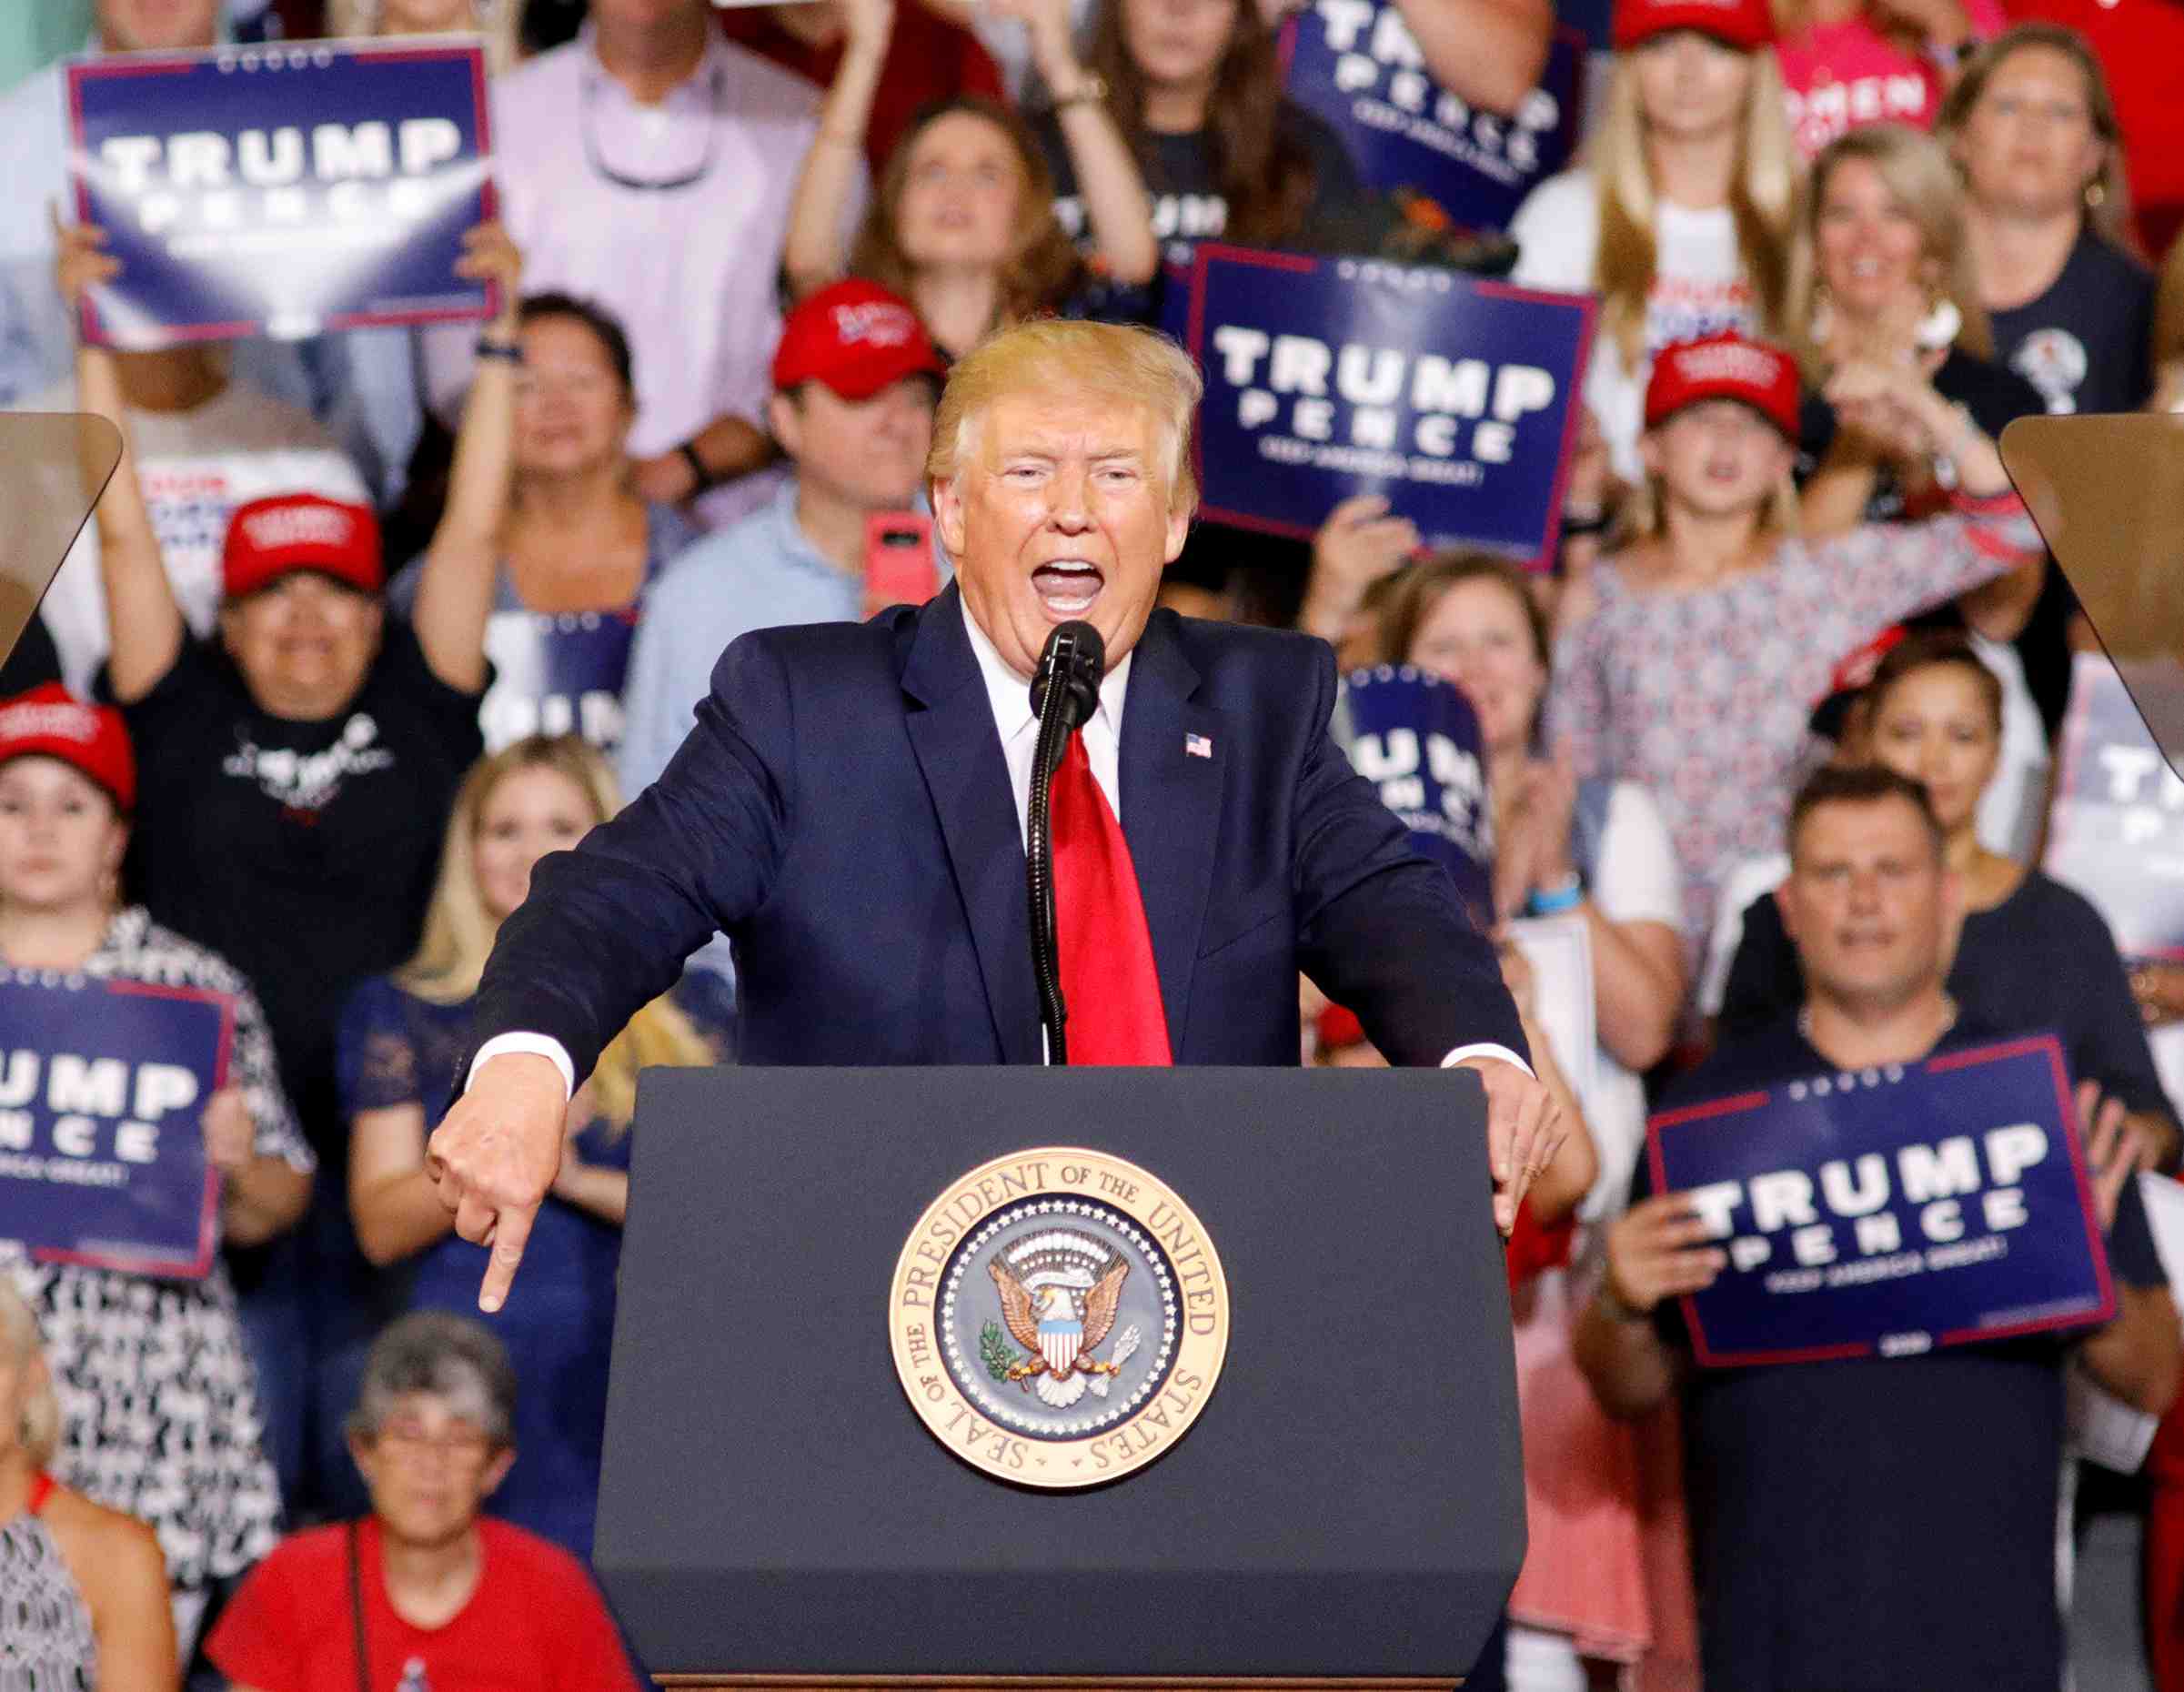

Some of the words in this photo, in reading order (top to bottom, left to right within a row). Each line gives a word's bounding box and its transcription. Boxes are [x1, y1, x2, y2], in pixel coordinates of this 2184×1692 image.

[1315, 0, 1559, 133] TRP
[101, 118, 460, 191] TRUMP
[1213, 324, 1555, 422] TRUMP
[1238, 388, 1516, 464] PENCE
[1060, 1164, 1092, 1185] OF
[1099, 1171, 1141, 1205] THE
[1687, 1123, 2048, 1240] TRUMP
[902, 1162, 1051, 1310] PRESIDENT
[1147, 1200, 1216, 1337] UNITED
[1731, 1187, 2028, 1272] PENCE
[905, 1322, 930, 1368] THE
[919, 1373, 948, 1403] OF
[1090, 1366, 1203, 1470] STATES
[937, 1393, 1030, 1471] SEAL
